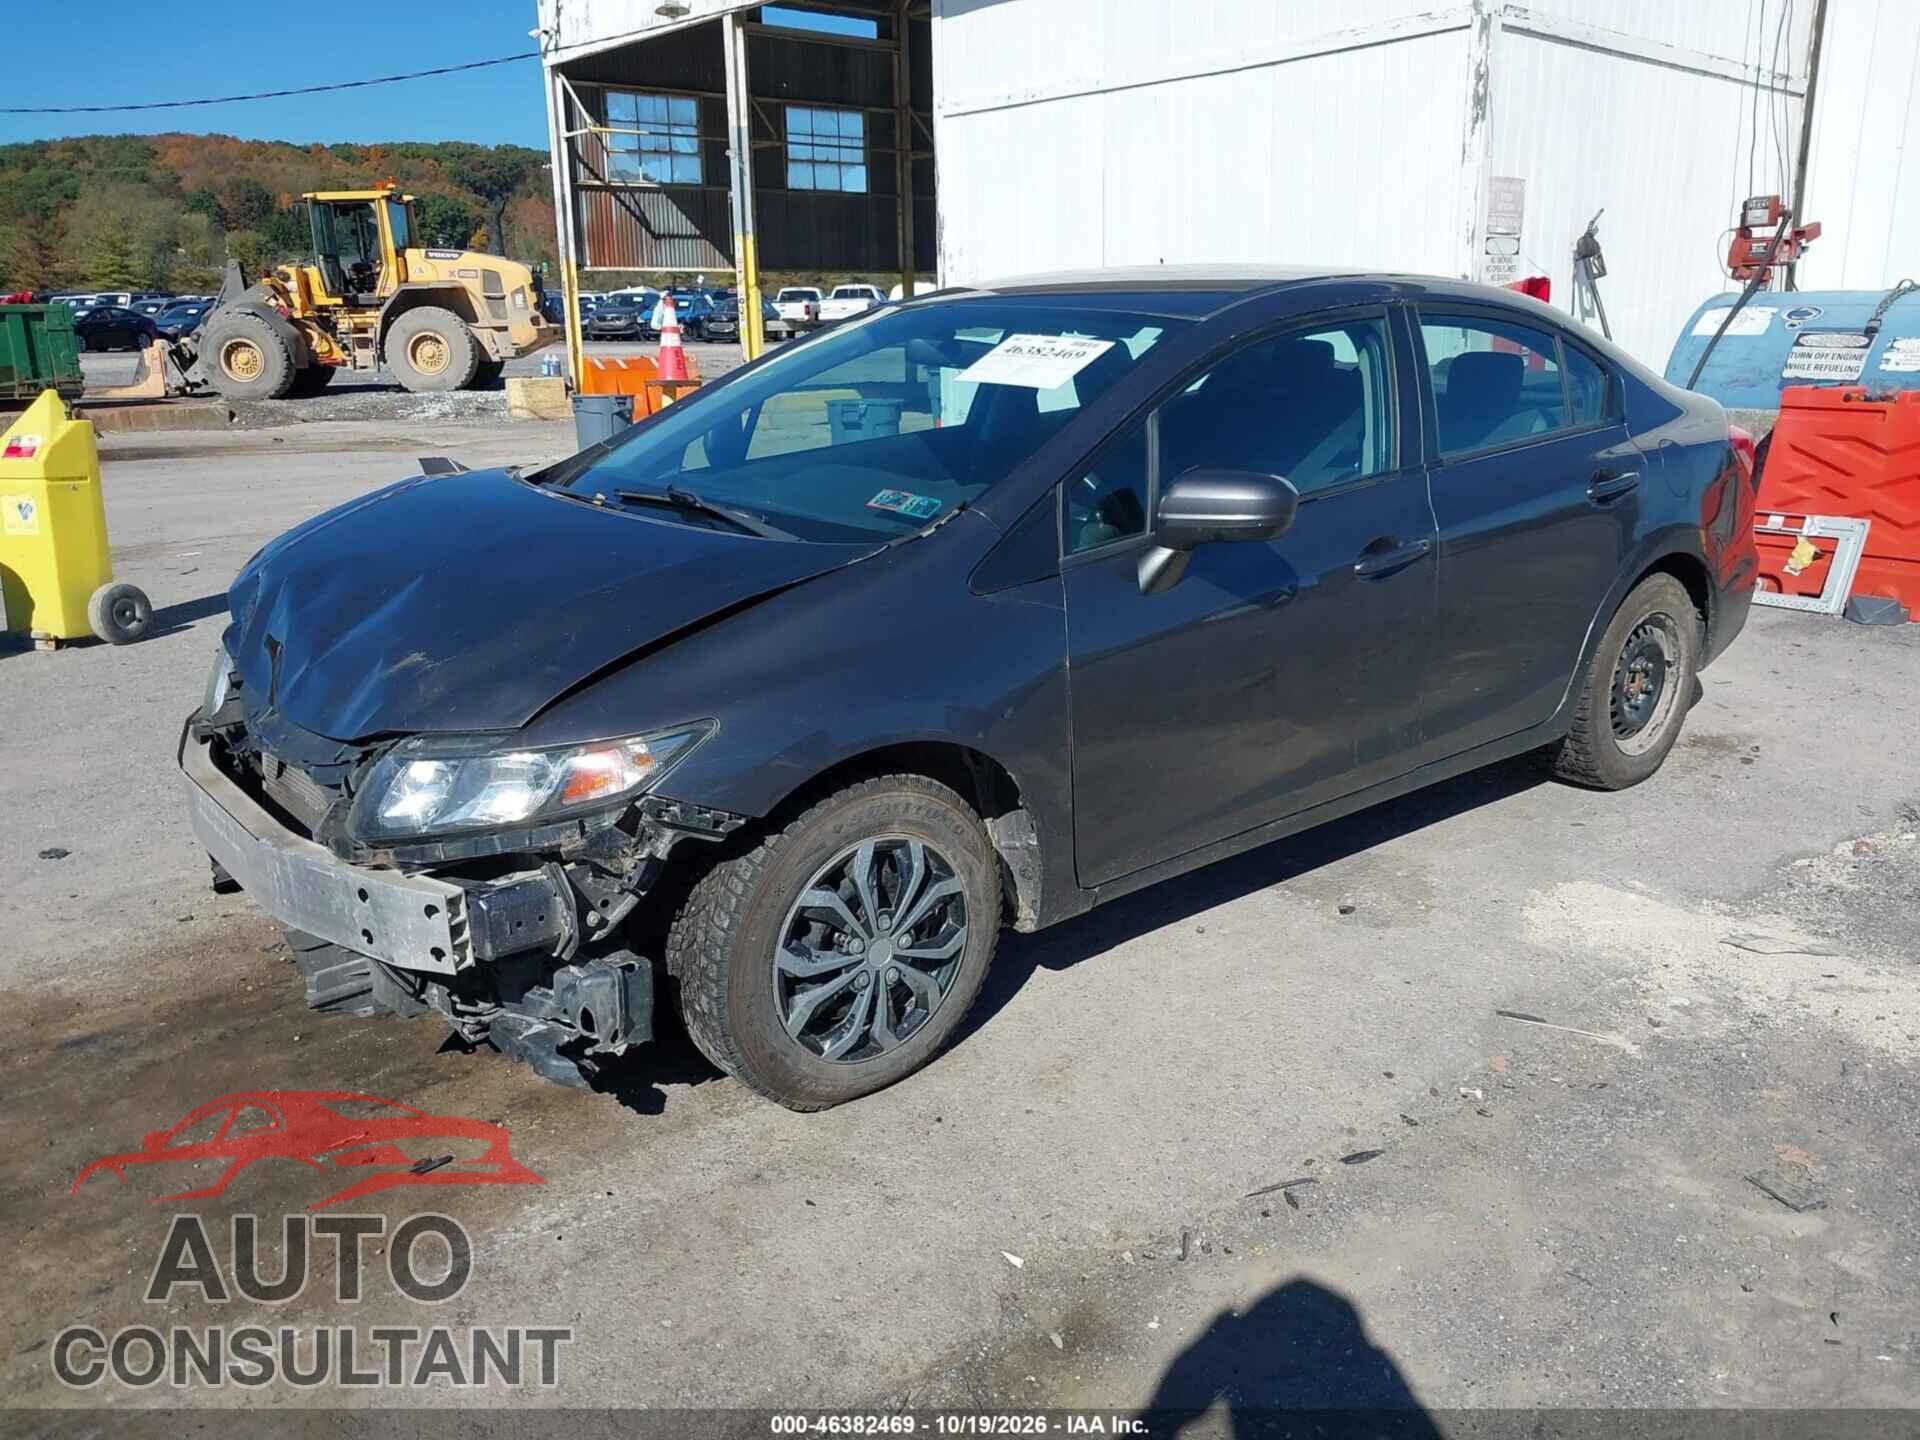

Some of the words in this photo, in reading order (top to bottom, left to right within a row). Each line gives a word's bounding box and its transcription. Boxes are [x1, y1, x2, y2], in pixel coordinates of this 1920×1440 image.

[1003, 344, 1088, 359] 46382469
[1790, 351, 1812, 360] TURN
[1814, 352, 1831, 361] OFF
[1831, 352, 1864, 362] ENGINE
[1786, 363, 1811, 371] WHILE
[1813, 363, 1860, 373] REFUELING
